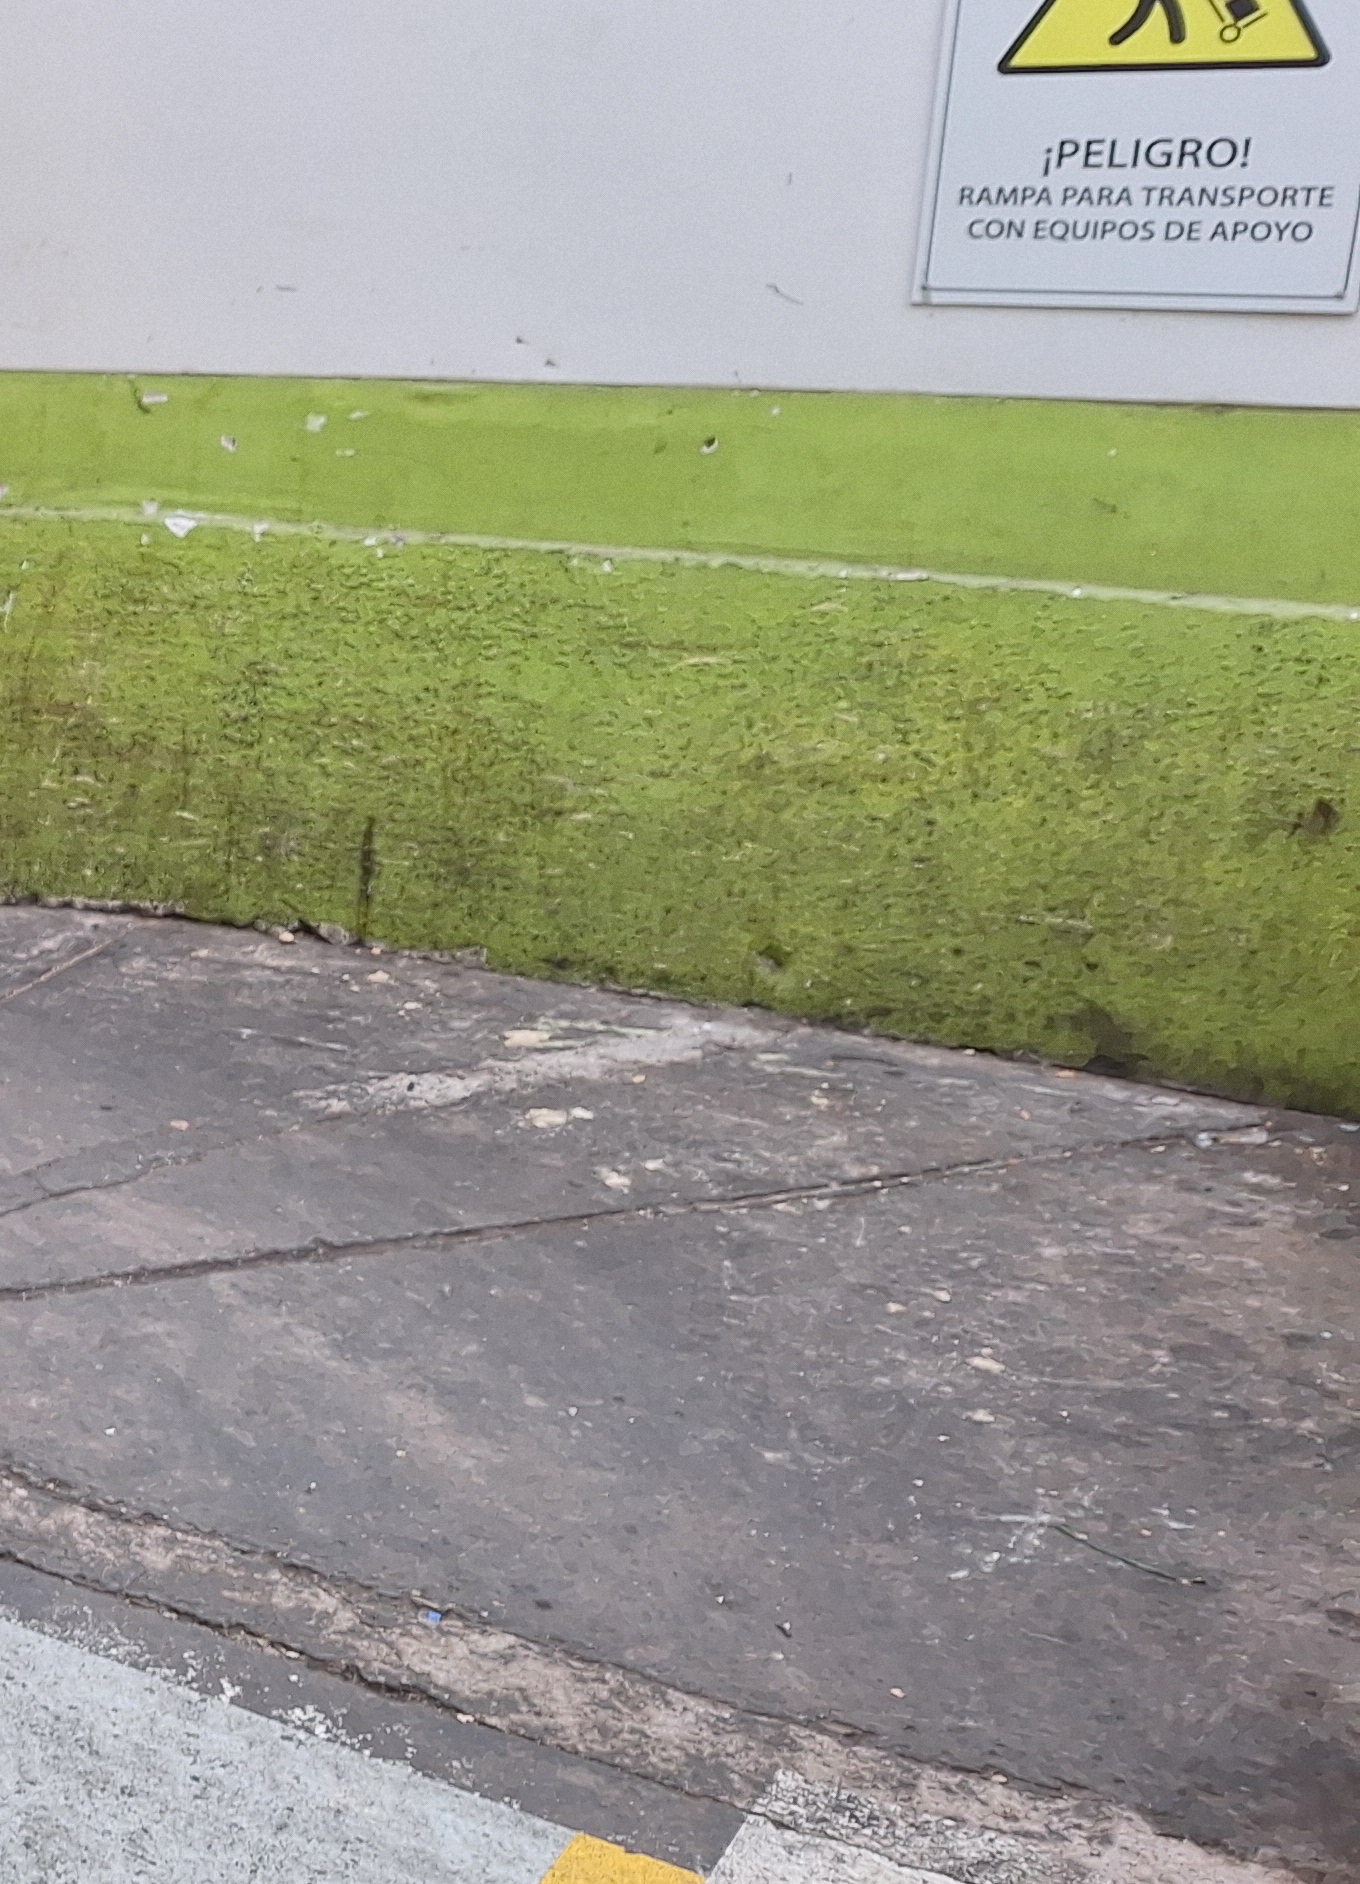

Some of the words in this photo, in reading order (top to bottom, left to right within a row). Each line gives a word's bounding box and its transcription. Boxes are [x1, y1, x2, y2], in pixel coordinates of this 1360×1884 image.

[1043, 137, 1252, 177] ¡PELIGRO!
[959, 185, 1053, 207] RAMPA
[1061, 186, 1133, 207] PARA
[1141, 185, 1335, 208] TRANSPORTE
[968, 218, 1025, 240] CON
[1033, 219, 1155, 241] EQUIPOS
[1164, 220, 1201, 241] DE
[1209, 220, 1314, 242] APOYO
